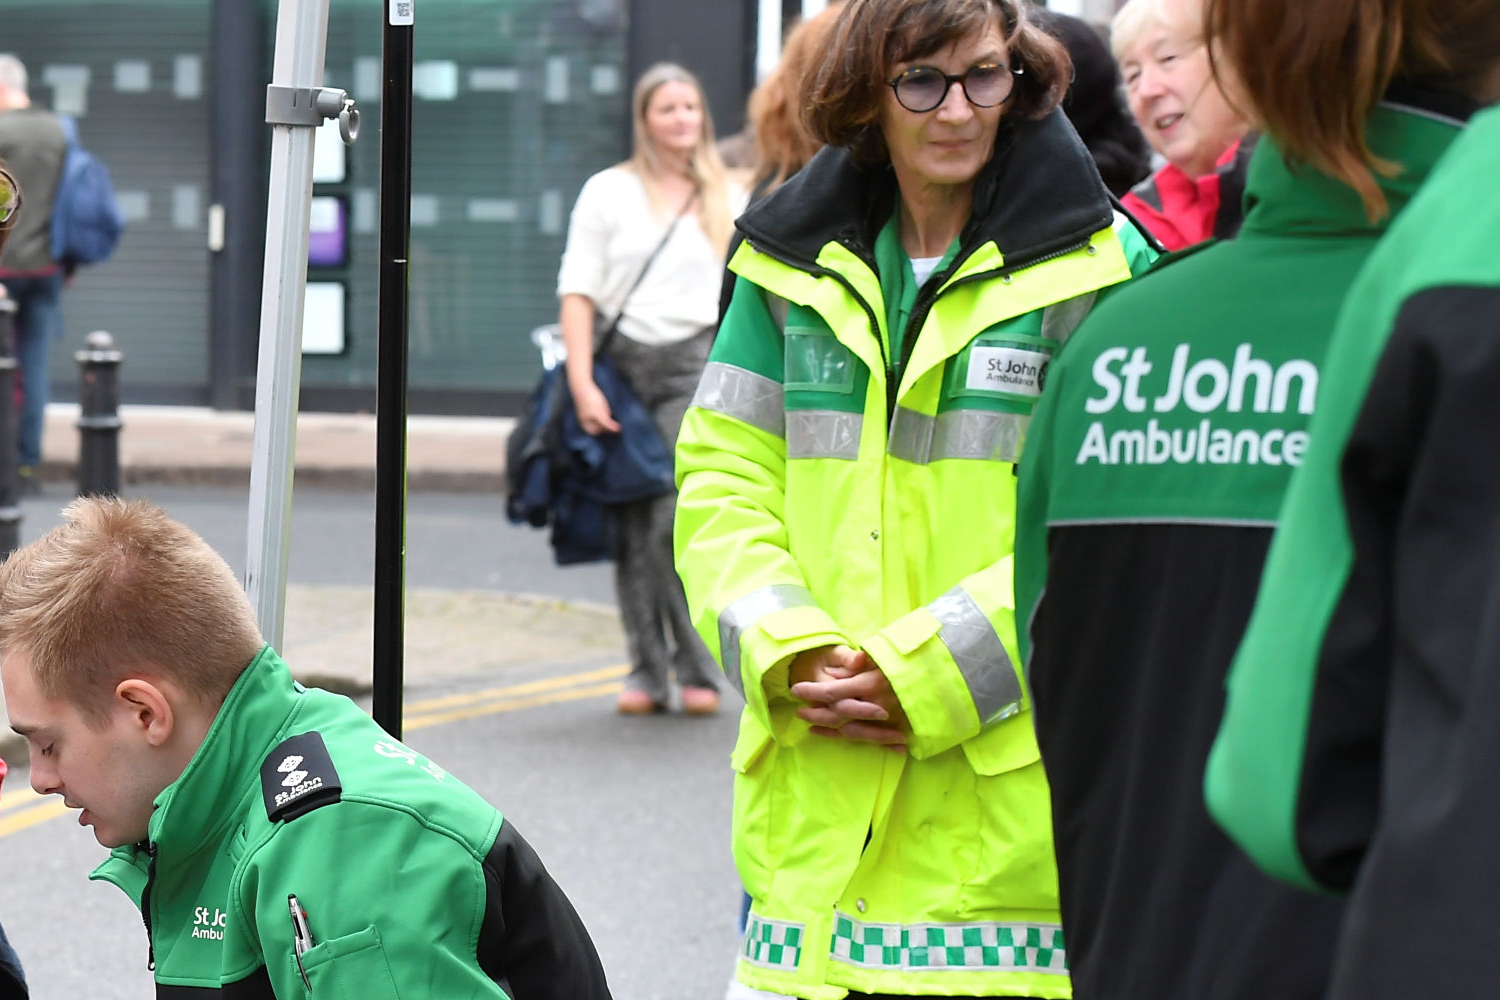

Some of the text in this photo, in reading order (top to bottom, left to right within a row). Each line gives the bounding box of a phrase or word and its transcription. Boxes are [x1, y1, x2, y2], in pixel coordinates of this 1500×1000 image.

[987, 358, 1037, 376] St John
[1085, 343, 1319, 414] St John
[1075, 418, 1310, 466] Ambulance
[374, 739, 417, 766] St
[193, 906, 226, 927] St Jo
